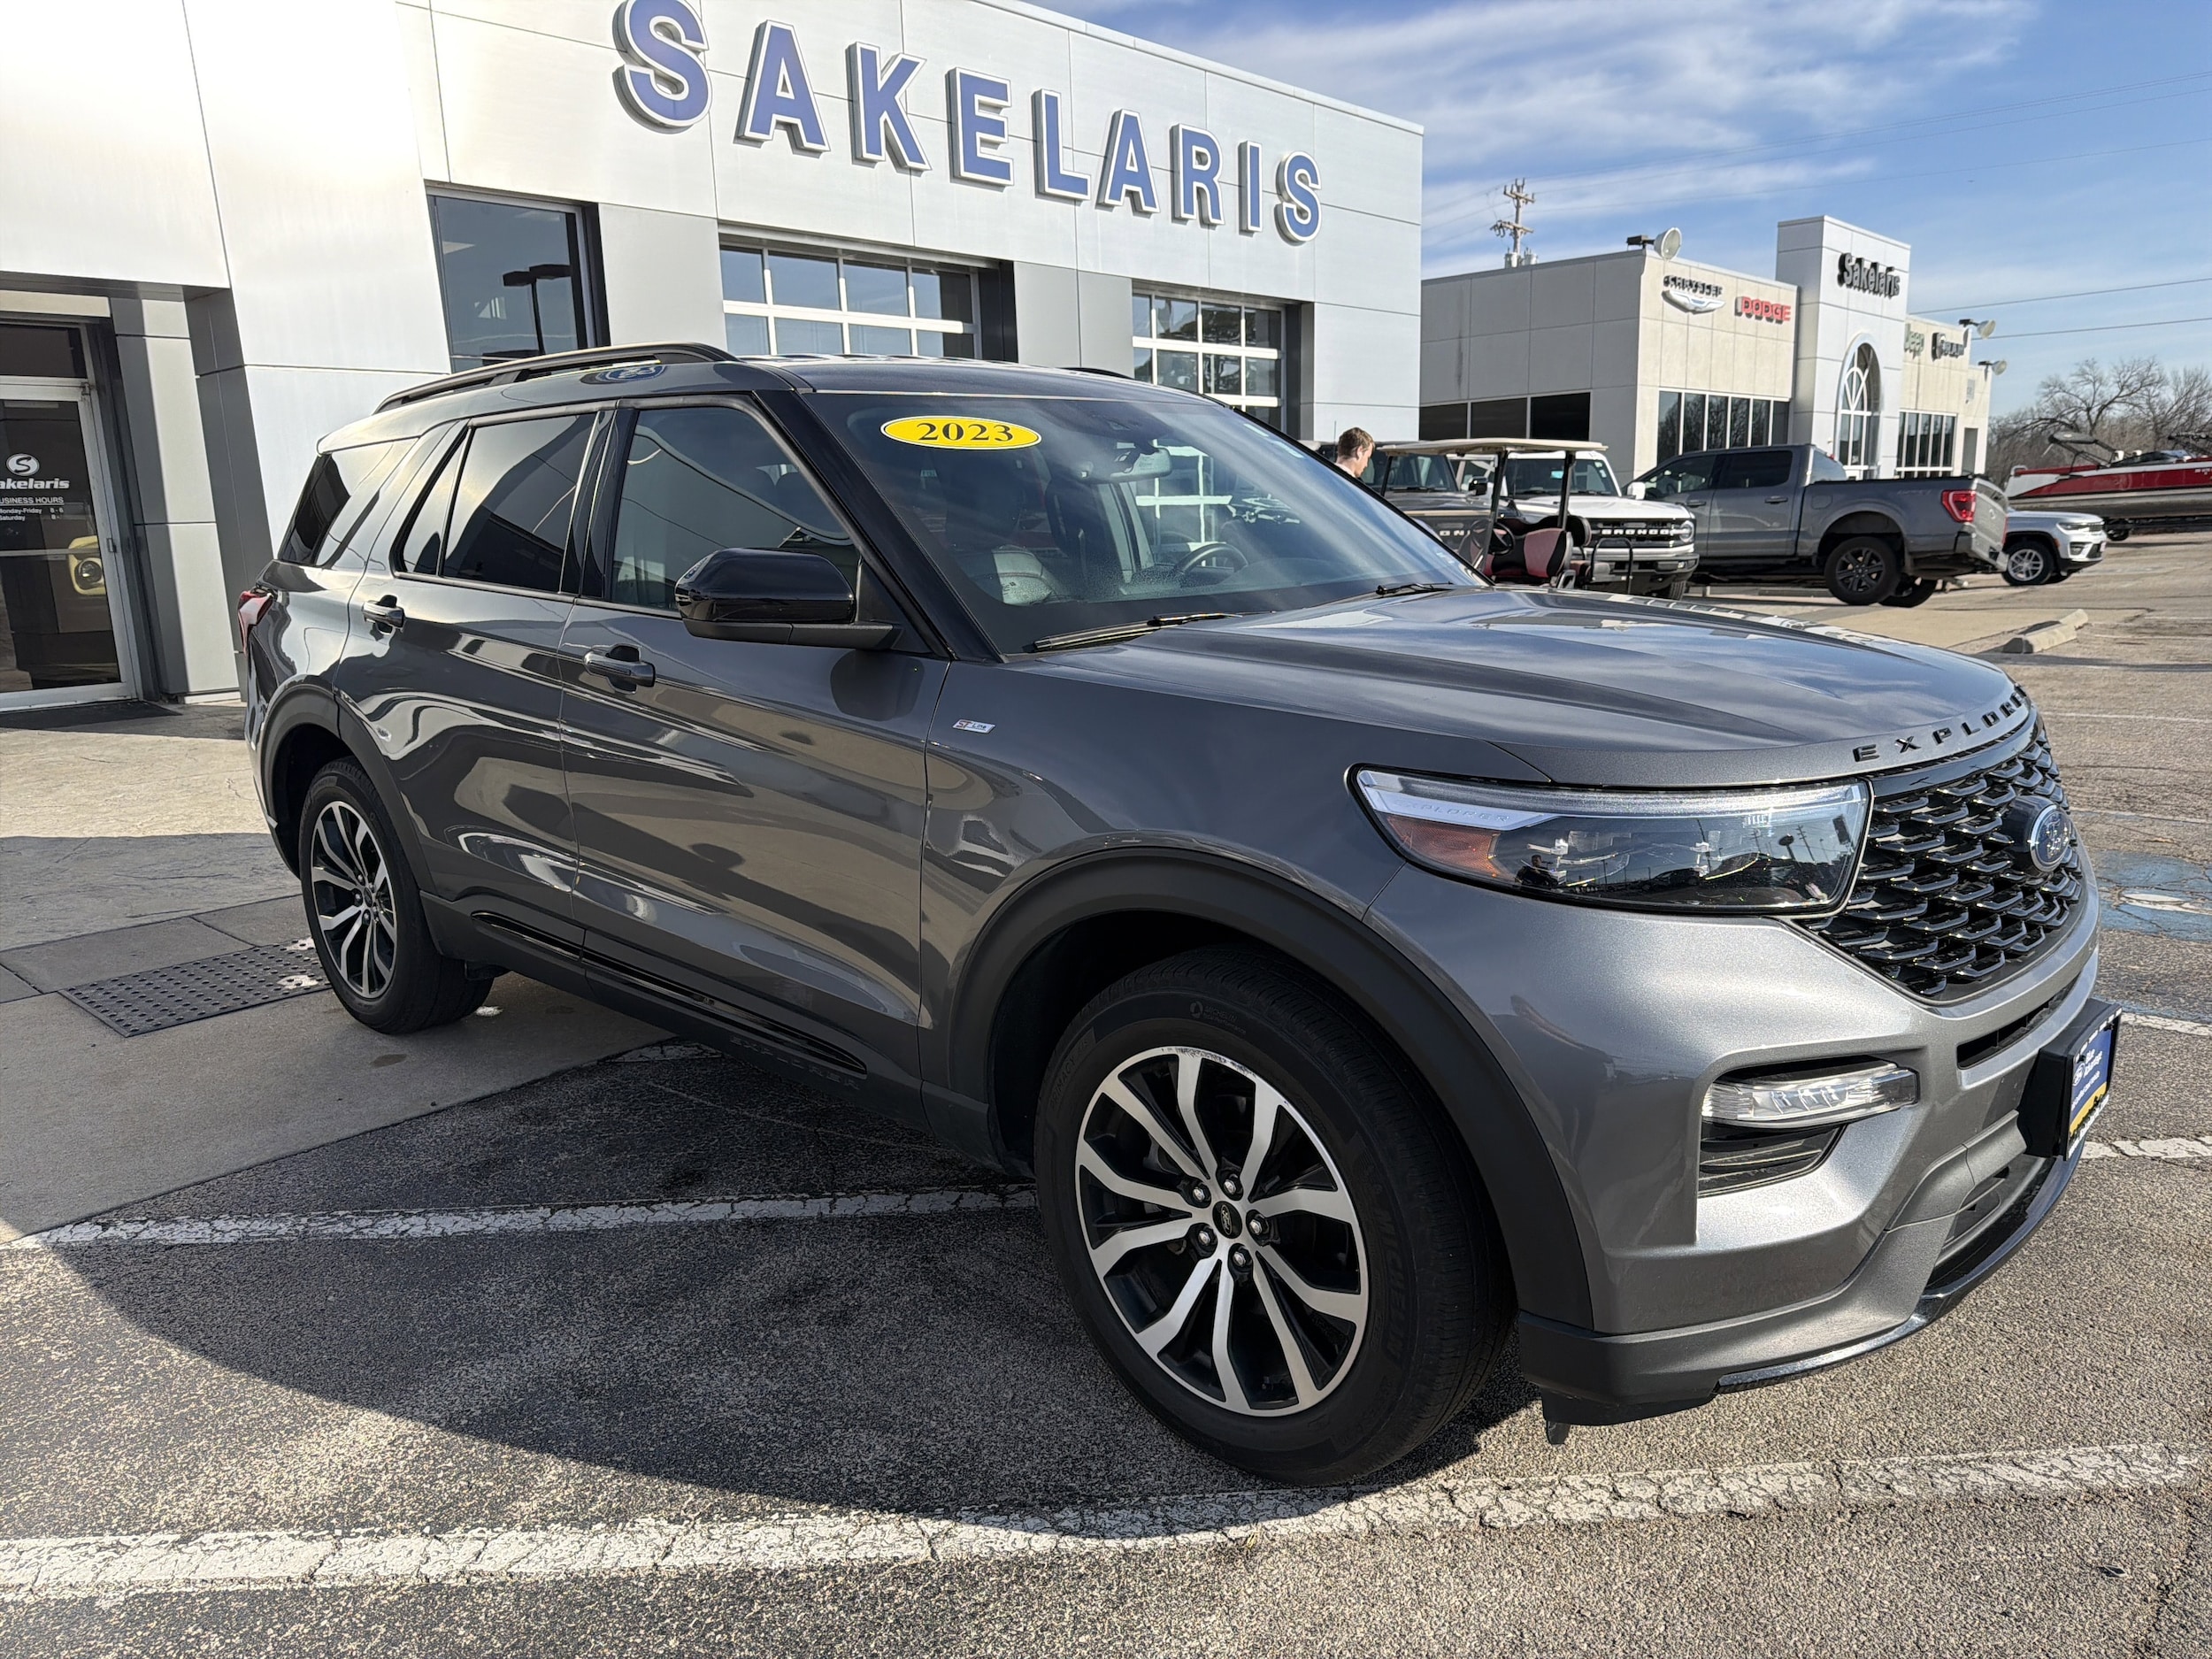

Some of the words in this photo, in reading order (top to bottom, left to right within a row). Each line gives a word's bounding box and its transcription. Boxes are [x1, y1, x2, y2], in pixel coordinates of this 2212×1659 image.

[614, 0, 1323, 244] SAKELARIS
[1839, 252, 1901, 297] Sakelaris
[1739, 296, 1792, 322] DODGE
[917, 422, 1014, 442] 2023
[0, 478, 70, 489] akelaris
[1853, 683, 2027, 763] EXPLORE
